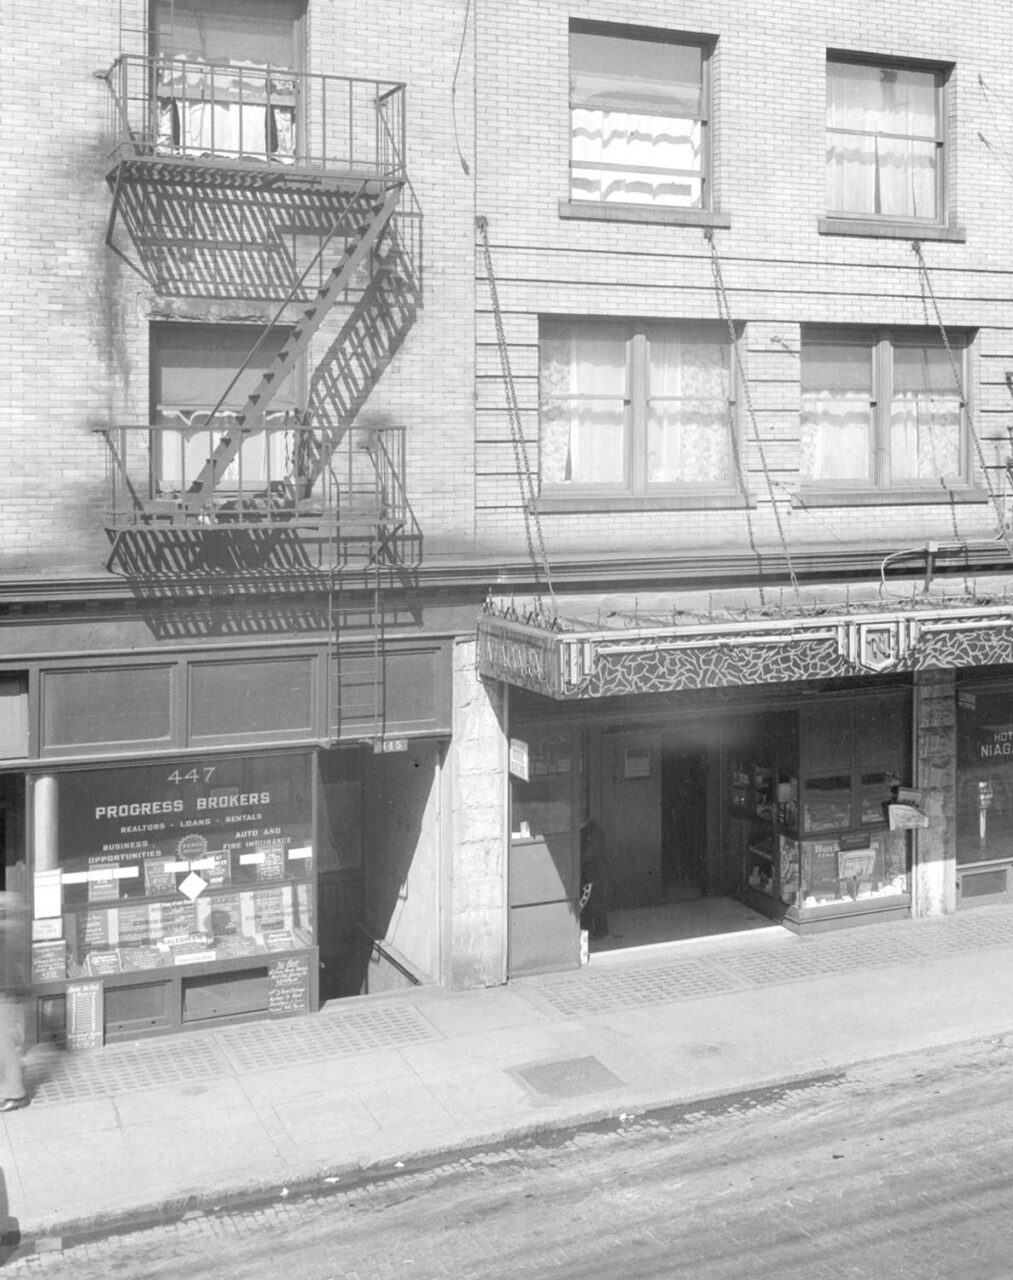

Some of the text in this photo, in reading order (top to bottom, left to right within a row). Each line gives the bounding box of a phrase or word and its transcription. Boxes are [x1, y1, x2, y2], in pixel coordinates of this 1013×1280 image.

[167, 766, 216, 785] 447
[95, 792, 271, 820] PROGRESS BROKERS
[120, 822, 166, 834] REALTORS
[180, 818, 211, 828] LOANS
[225, 813, 263, 823] RENTALS
[235, 827, 281, 839] AUTO AND
[102, 840, 149, 852] BUSINESS
[223, 836, 293, 851] FIRE INSURANCE
[88, 850, 162, 864] OPPORTUNITIES
